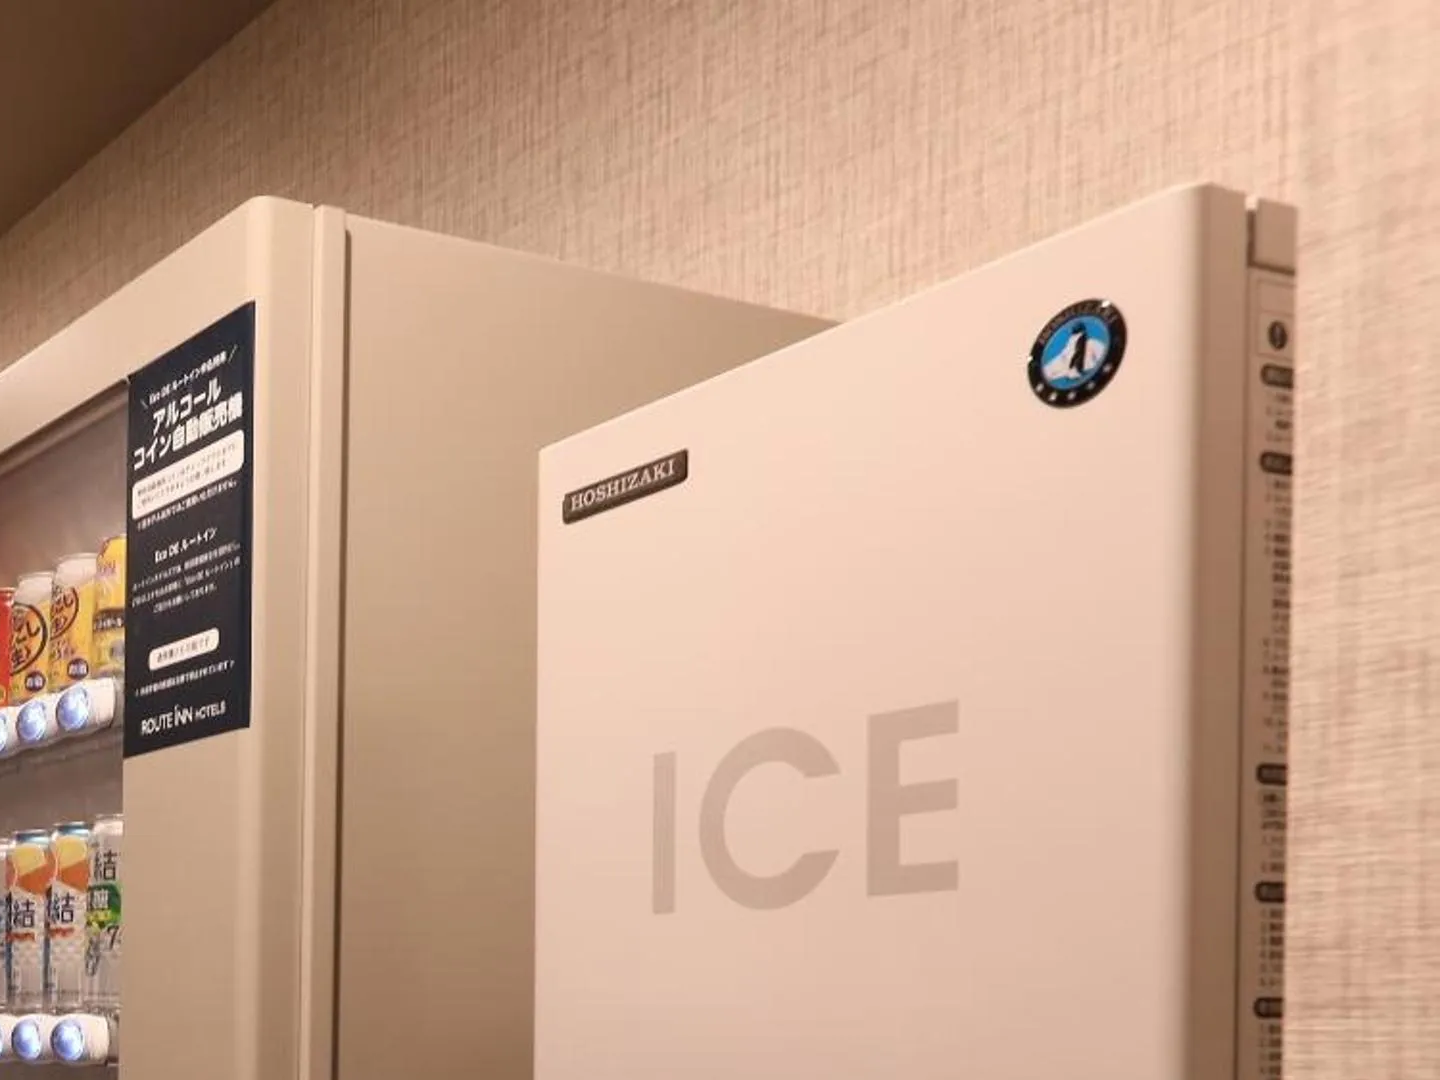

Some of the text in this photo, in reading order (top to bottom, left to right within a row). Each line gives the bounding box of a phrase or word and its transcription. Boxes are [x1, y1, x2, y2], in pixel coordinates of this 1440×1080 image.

[153, 377, 221, 437] アルコール
[569, 457, 676, 512] HOSHIZAKI
[141, 711, 174, 736] ROUTE
[652, 698, 959, 914] ICE
